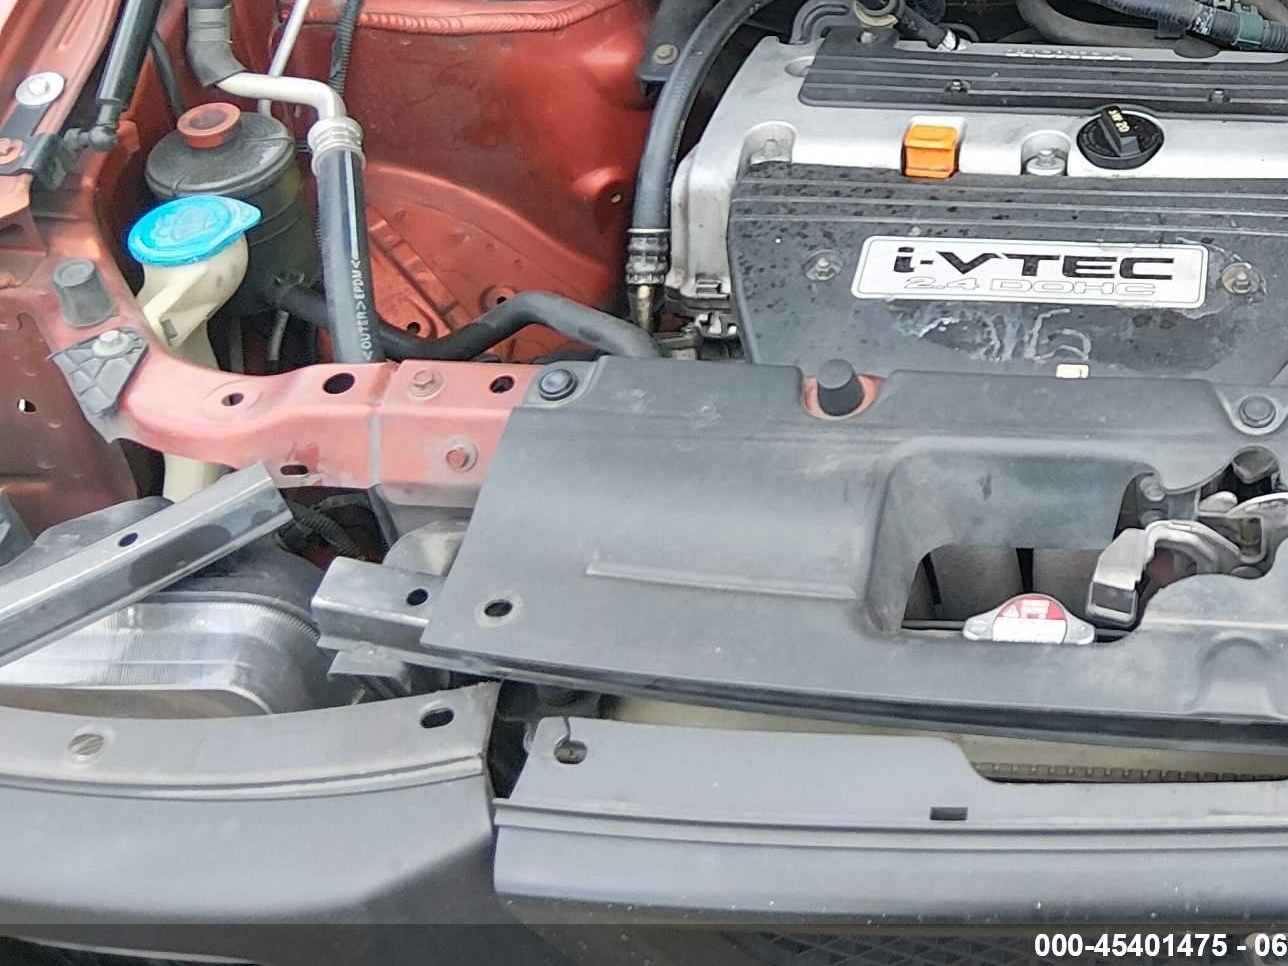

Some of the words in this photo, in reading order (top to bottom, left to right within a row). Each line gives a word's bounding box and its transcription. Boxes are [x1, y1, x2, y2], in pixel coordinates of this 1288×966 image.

[893, 246, 1175, 281] i-VTEC
[904, 276, 980, 291] 2.4
[990, 278, 1157, 296] DOHC
